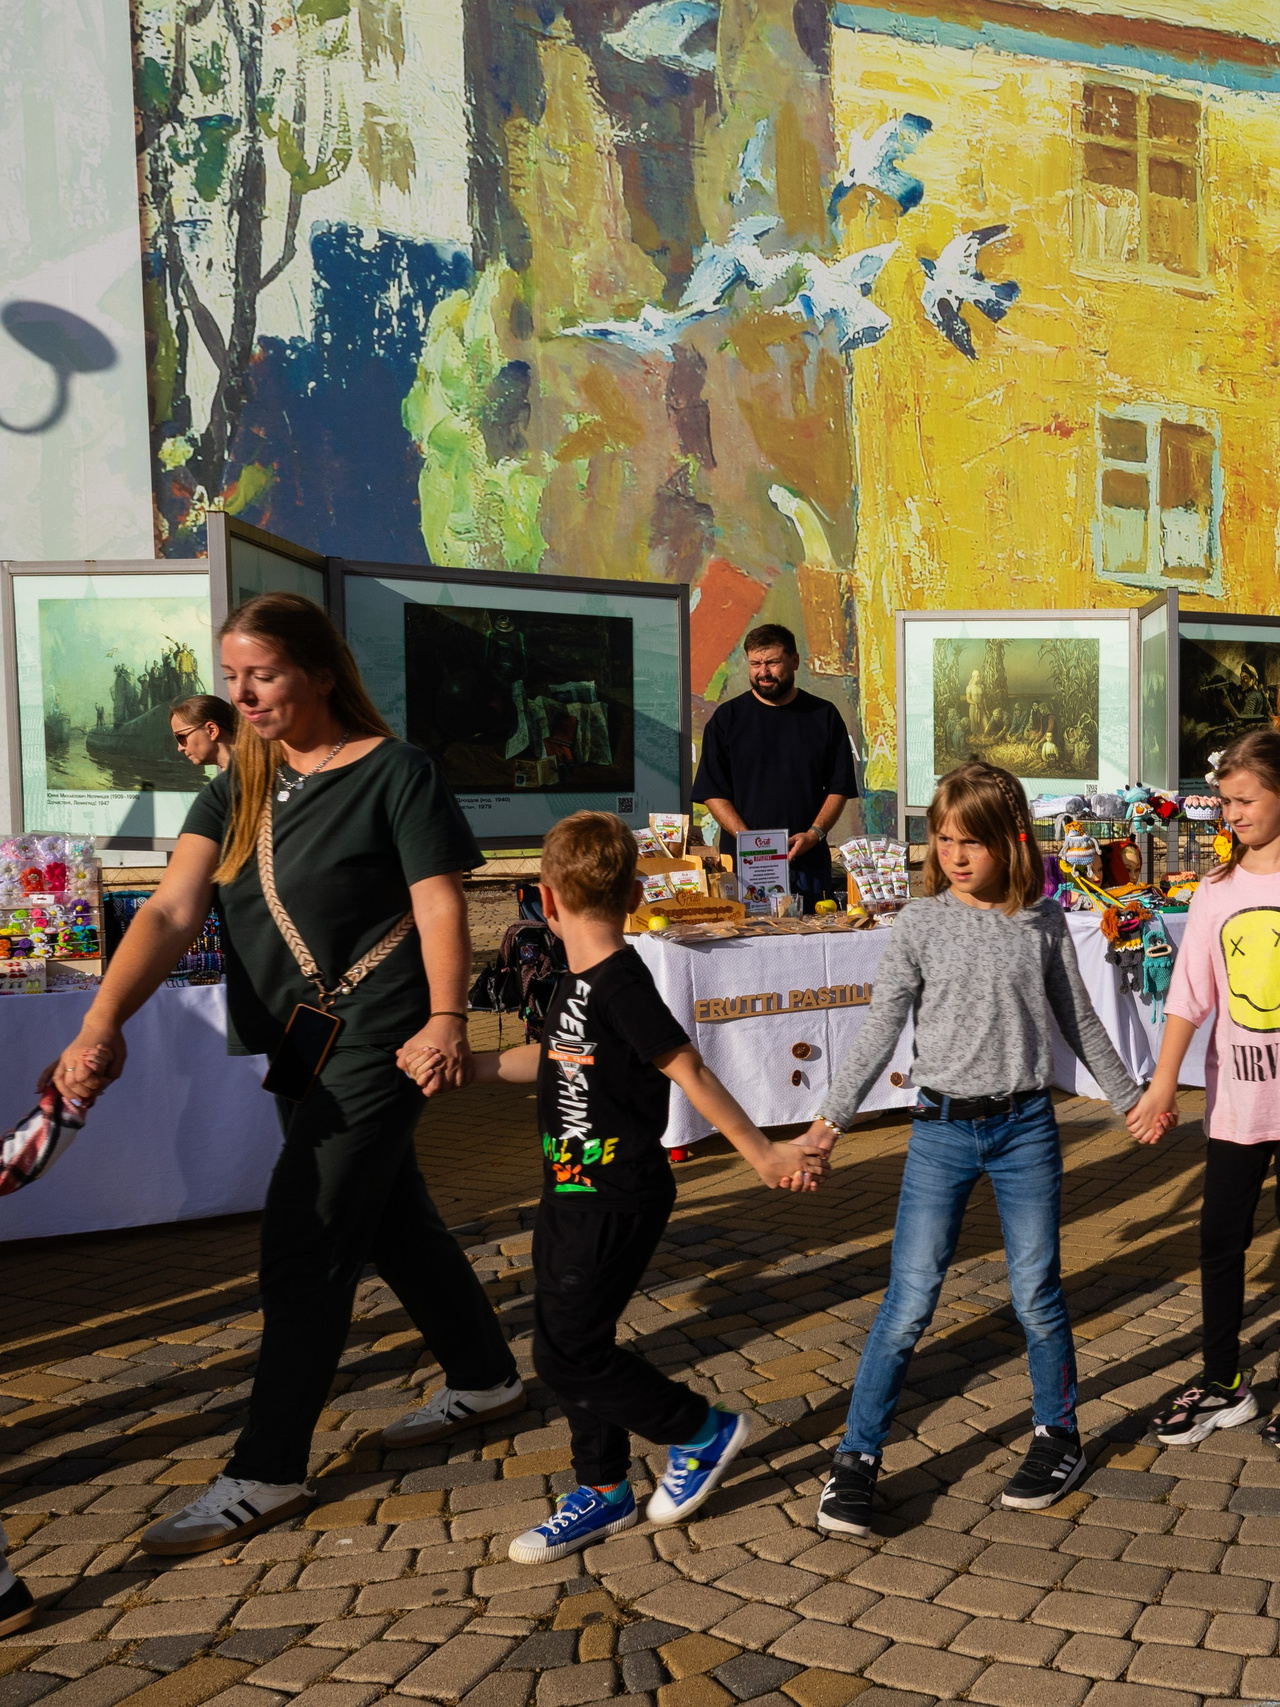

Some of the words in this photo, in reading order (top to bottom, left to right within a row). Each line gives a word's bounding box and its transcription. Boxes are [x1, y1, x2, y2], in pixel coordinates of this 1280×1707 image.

[694, 991, 779, 1022] FRUTTI
[788, 981, 874, 1011] PASTILL
[582, 1136, 620, 1166] BE
